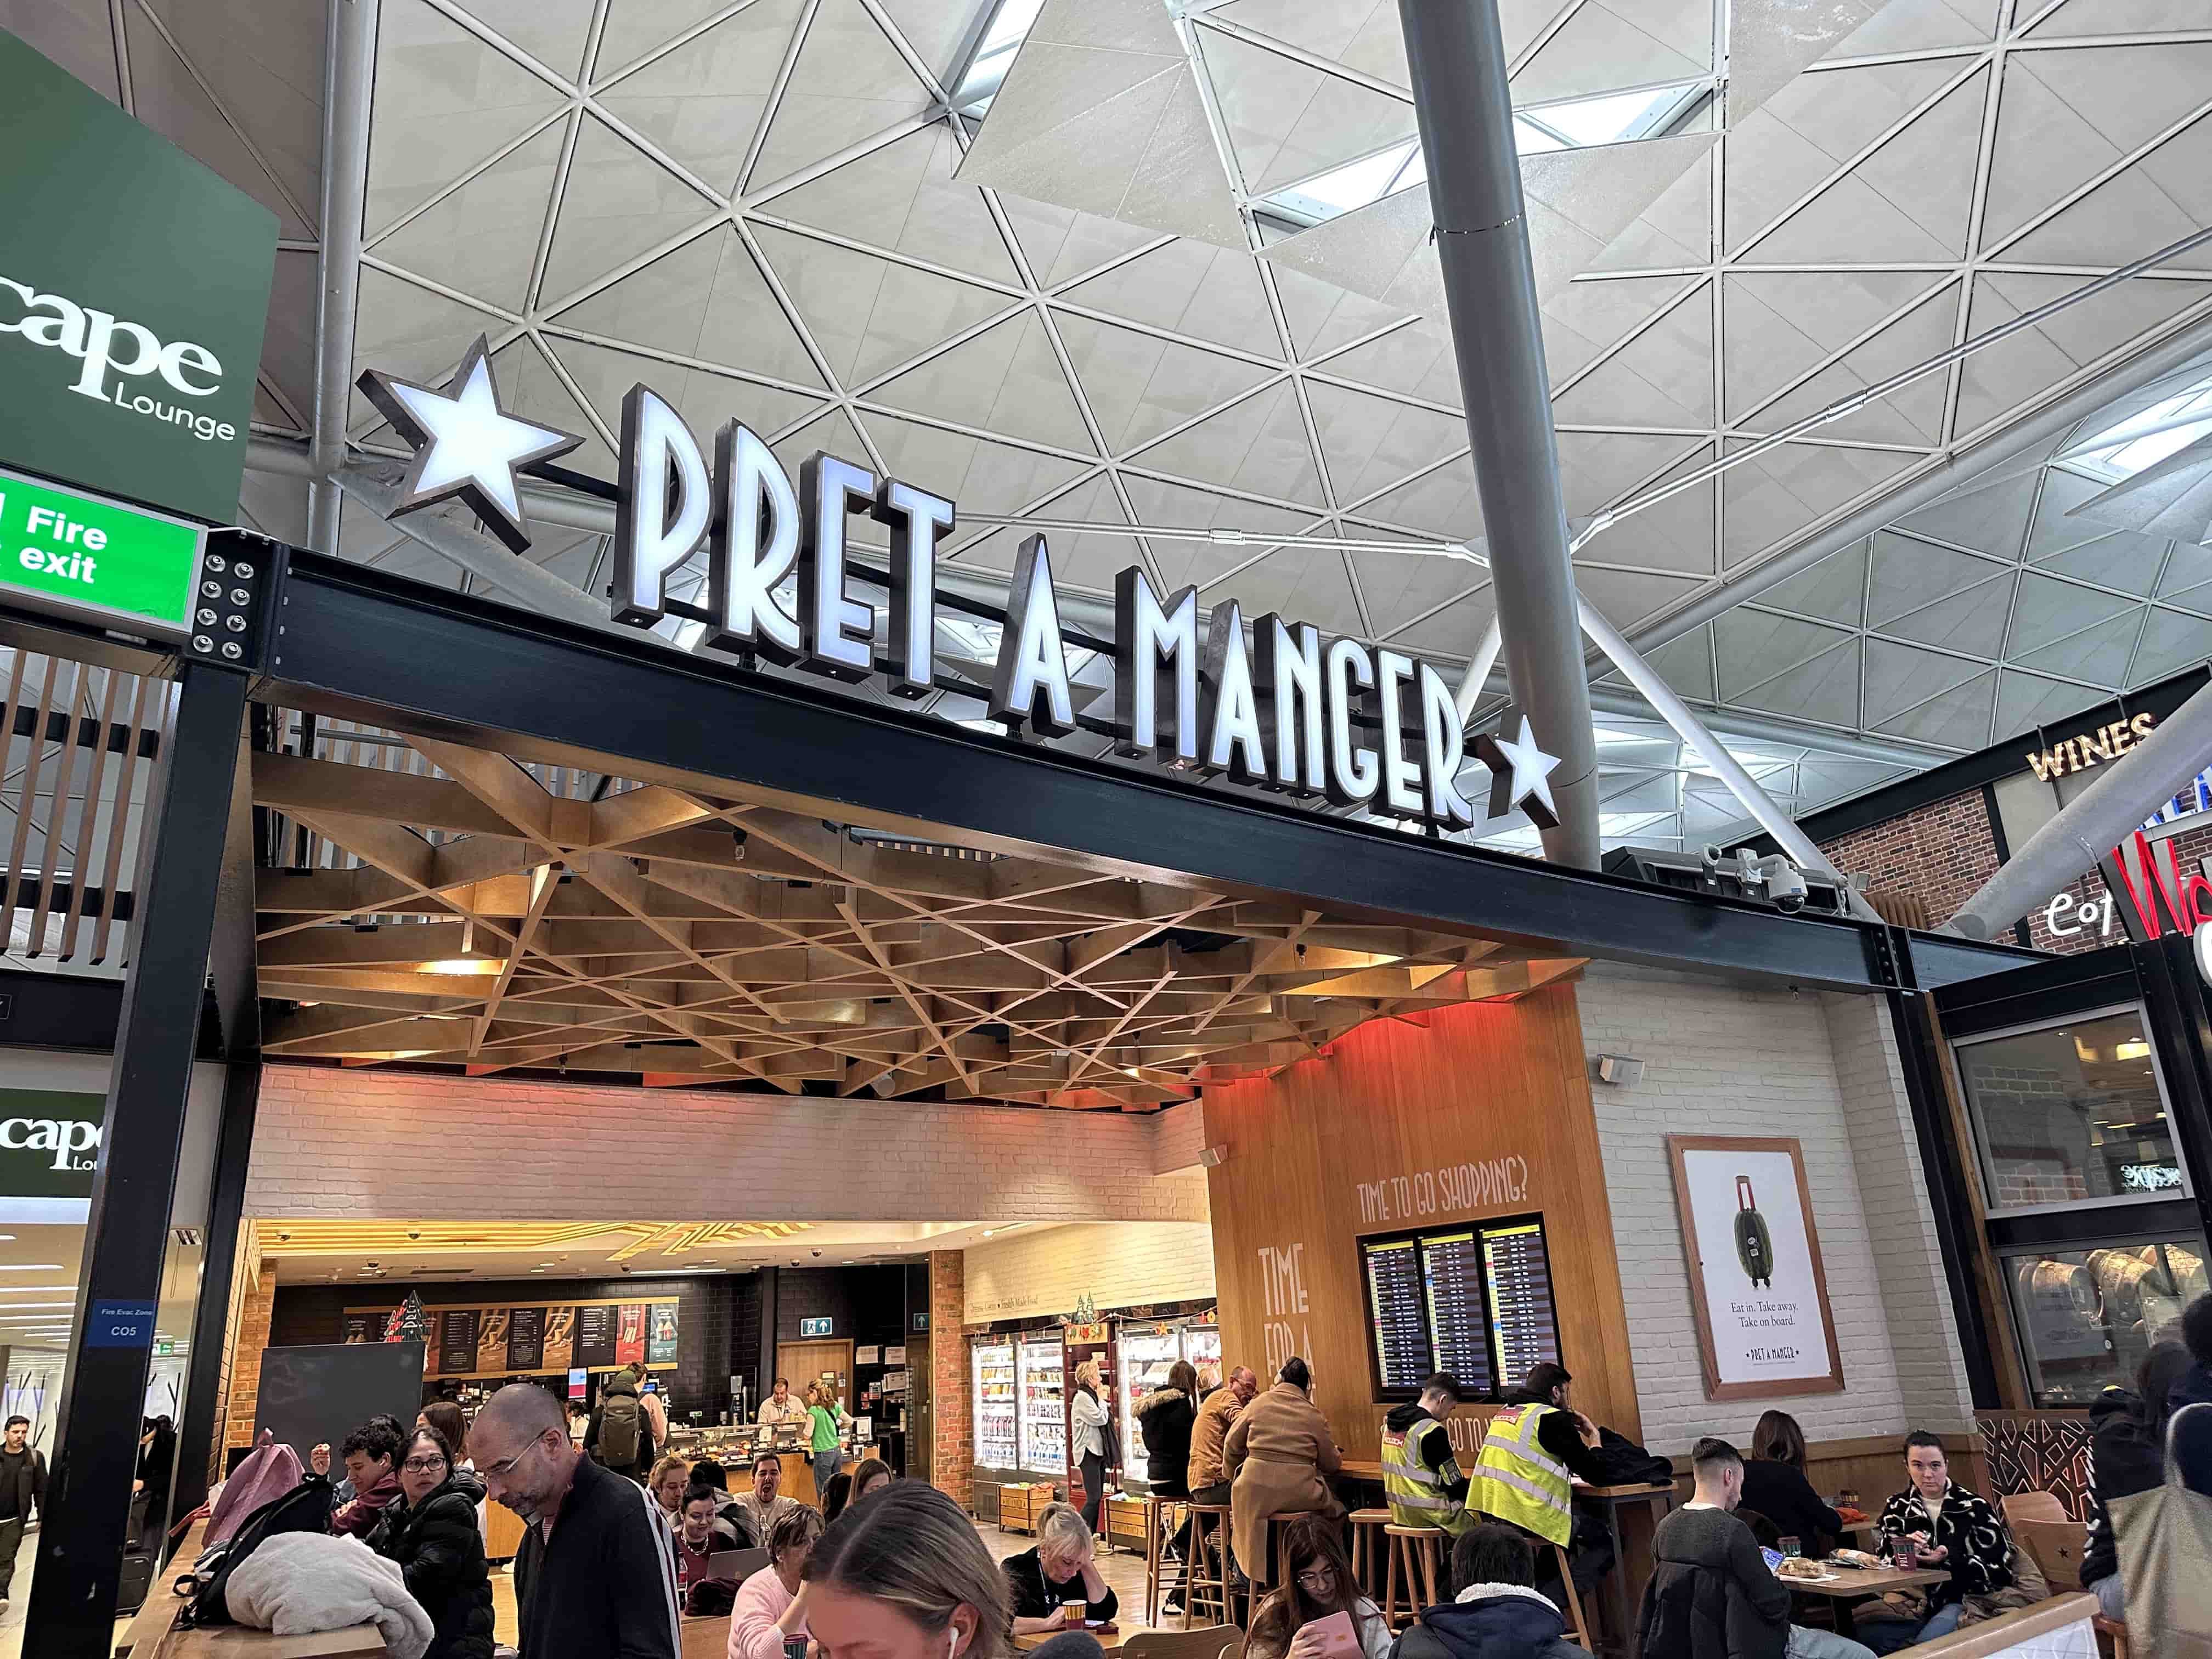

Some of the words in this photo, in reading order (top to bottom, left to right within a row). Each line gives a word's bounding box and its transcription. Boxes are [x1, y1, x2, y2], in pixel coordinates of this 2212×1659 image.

[115, 381, 236, 441] Lounge
[27, 506, 108, 550] Fire
[20, 546, 97, 584] exit
[617, 383, 955, 693] PRET
[994, 534, 1076, 734] A
[1118, 566, 1472, 828] MANGER
[2025, 712, 2154, 782] WINES
[0, 1118, 103, 1170] cap
[1357, 1180, 1390, 1223] TIME
[1391, 1176, 1412, 1218] TO
[1414, 1172, 1436, 1215] GO
[1438, 1154, 1528, 1211] SHOPPING?
[1257, 1243, 1310, 1317] TIME
[1730, 1302, 1745, 1312] Eat
[1746, 1302, 1756, 1312] in.
[1756, 1301, 1776, 1312] Take
[1777, 1303, 1798, 1313] away.
[1738, 1317, 1758, 1327] Take
[1770, 1314, 1795, 1326] board.
[1751, 1347, 1765, 1361] PRET
[1767, 1348, 1771, 1360] A
[1771, 1347, 1795, 1359] MANGER
